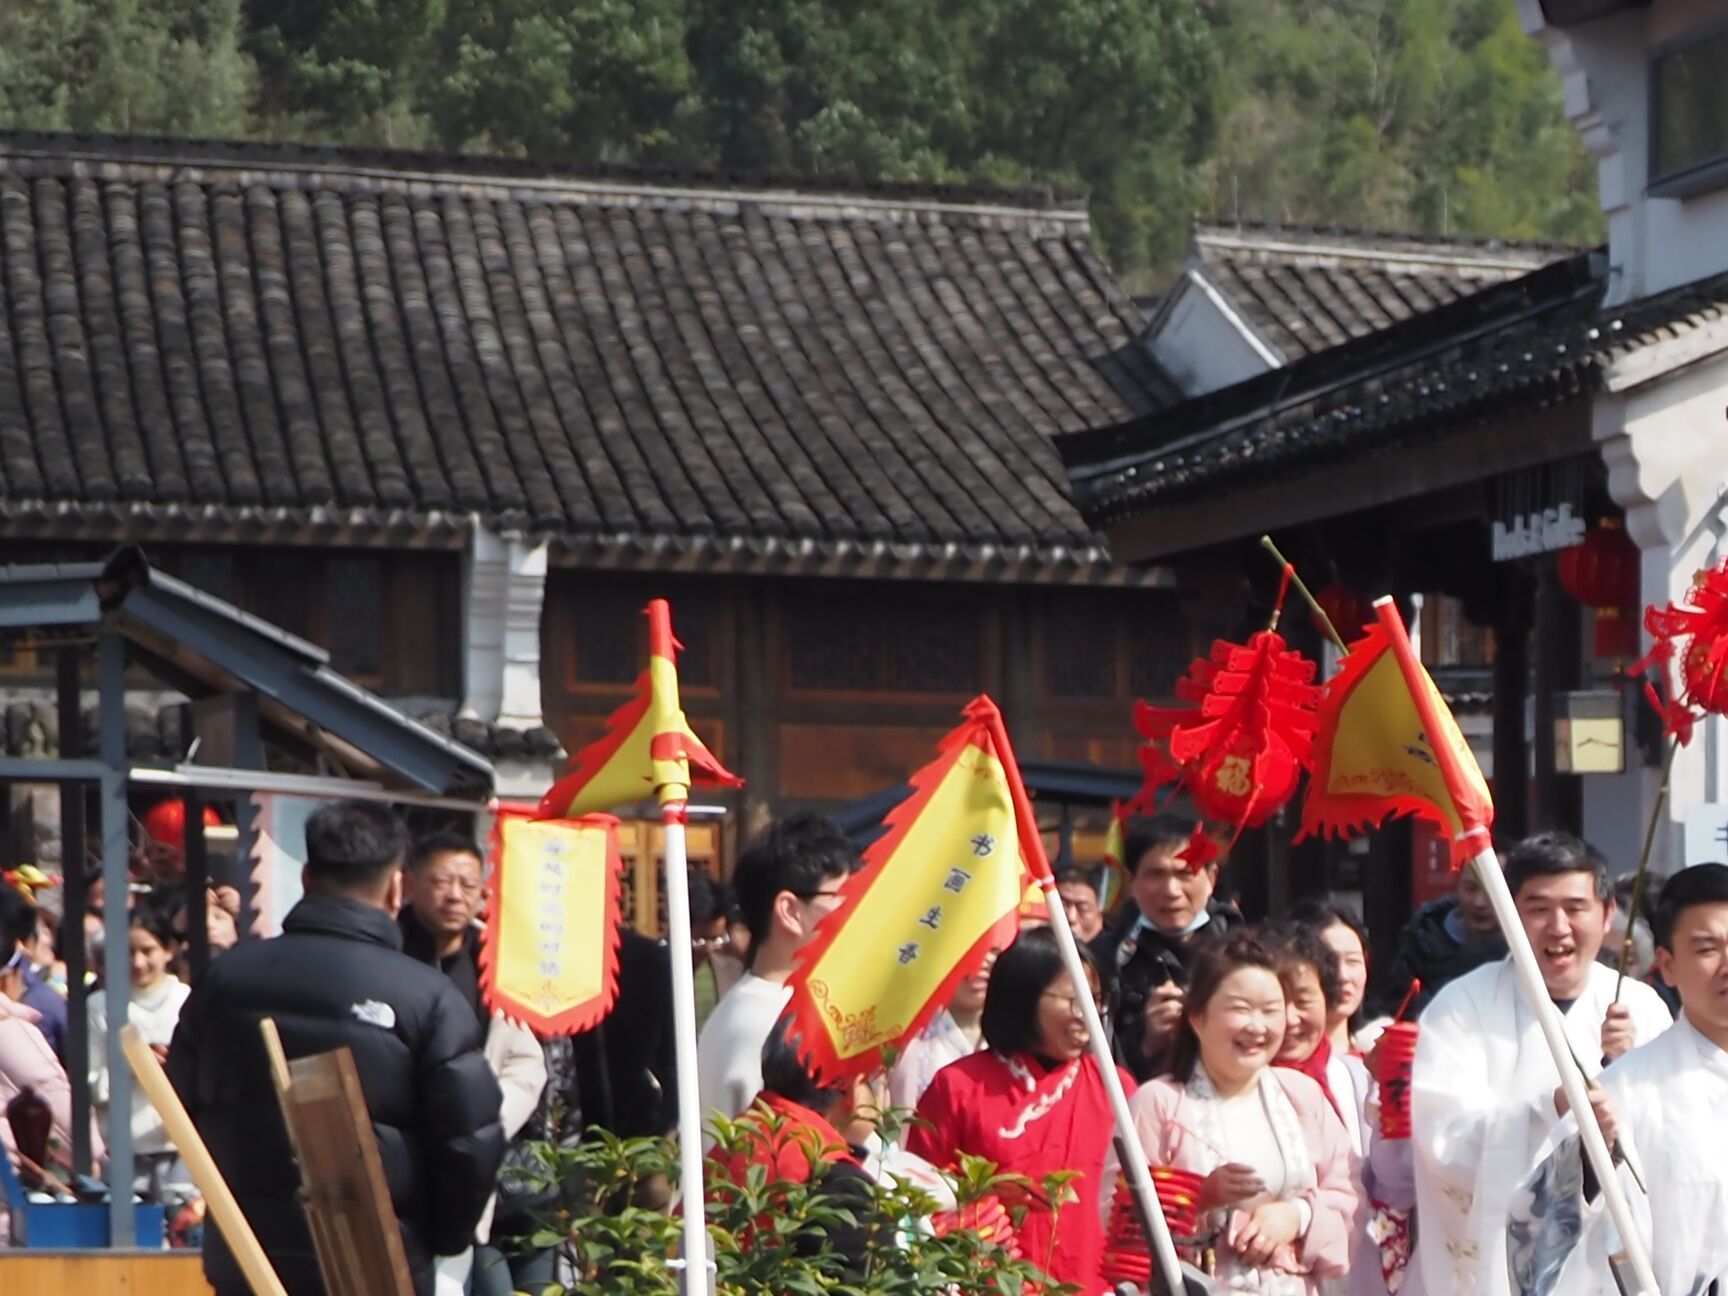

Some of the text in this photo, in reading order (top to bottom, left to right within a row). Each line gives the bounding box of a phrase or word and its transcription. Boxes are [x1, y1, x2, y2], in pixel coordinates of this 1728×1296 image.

[1215, 755, 1253, 797] 福
[897, 833, 995, 966] 书画生香
